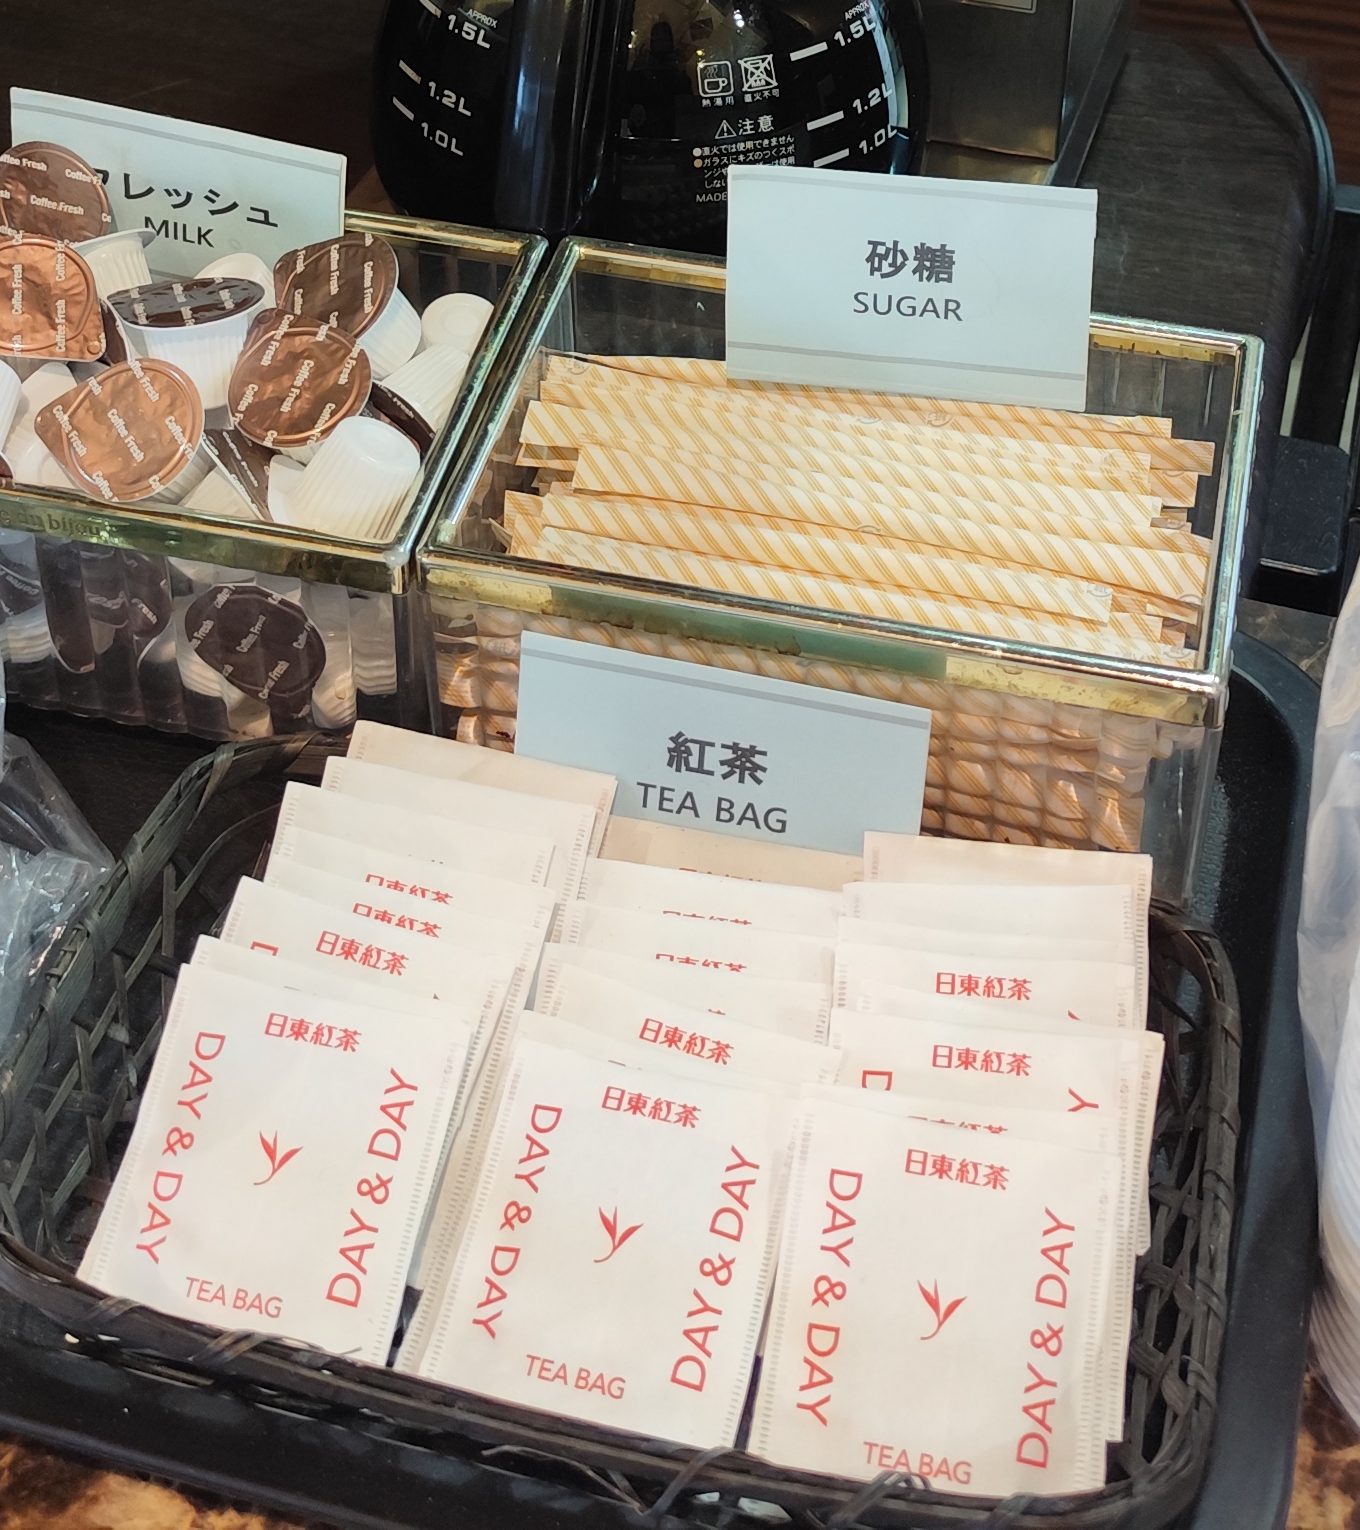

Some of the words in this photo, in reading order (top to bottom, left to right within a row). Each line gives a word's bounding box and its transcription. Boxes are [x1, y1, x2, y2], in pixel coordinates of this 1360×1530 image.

[466, 8, 498, 29] APPROX
[843, 0, 870, 23] APPROX
[446, 13, 491, 50] 1.5L
[833, 17, 877, 48] 1.5L
[428, 81, 472, 117] 1.2L
[744, 89, 780, 103] 直火不可
[851, 83, 893, 115] 1.2L
[421, 122, 464, 157] 1.0L
[738, 115, 774, 136] 注意
[858, 124, 897, 156] 1.0L
[702, 134, 794, 156] 直火では使用できません
[703, 145, 795, 167] ガラスにキズのつくスポ
[22, 158, 47, 172] Fresh
[65, 168, 91, 184] Coffee
[30, 194, 58, 210] Coffee
[58, 202, 85, 216] Fresh
[696, 192, 727, 202] MADE
[145, 216, 214, 248] MILK
[55, 253, 65, 282] Coffee
[330, 243, 340, 271] Coffee
[865, 238, 956, 284] 砂糖
[12, 264, 23, 288] Fresh
[330, 271, 340, 296] Fresh
[363, 261, 374, 288] Coffee
[12, 289, 23, 315] Coffee
[55, 299, 66, 325] Fresh
[363, 288, 374, 314] Fresh
[852, 291, 963, 322] SUGAR
[55, 325, 66, 352] Coffee
[276, 314, 294, 341] Coffee
[260, 338, 280, 366] Fresh
[294, 359, 315, 388] Coffee
[338, 356, 357, 385] Fresh
[140, 376, 159, 403] Fresh
[237, 383, 259, 413] Coffee
[280, 385, 300, 413] Fresh
[52, 404, 71, 434] Coffee
[68, 430, 87, 457] Fresh
[107, 408, 128, 438] Coffee
[124, 434, 145, 463] Fresh
[165, 415, 187, 446] Coffee
[666, 731, 767, 786] 紅茶
[636, 781, 702, 821] TEA
[714, 796, 788, 835] BAG
[315, 930, 409, 977] 日東紅茶
[935, 972, 1032, 1001] 日東紅茶
[265, 1012, 362, 1052] 日東紅茶
[639, 1017, 734, 1066] 日東紅茶
[177, 1031, 226, 1120] DAY
[932, 1044, 1032, 1077] 日東紅茶
[367, 1067, 419, 1161] DAY
[601, 1085, 702, 1129] 日東紅茶
[162, 1127, 195, 1156] &
[514, 1103, 563, 1193] DAY
[905, 1148, 1010, 1191] 日東紅茶
[356, 1172, 394, 1205] &
[709, 1145, 760, 1242] DAY
[136, 1171, 183, 1264] DAY
[500, 1200, 532, 1231] &
[820, 1168, 863, 1268] DAY
[326, 1208, 379, 1308] DAY
[699, 1253, 737, 1287] &
[1035, 1206, 1076, 1310] DAY
[185, 1276, 227, 1306] TEA
[233, 1287, 283, 1319] BAG
[472, 1245, 521, 1340] DAY
[811, 1274, 847, 1308] &
[670, 1288, 723, 1392] DAY
[1029, 1322, 1065, 1357] &
[526, 1354, 568, 1386] TEA
[575, 1367, 626, 1400] BAG
[796, 1322, 841, 1427] DAY
[1016, 1362, 1058, 1469] DAY
[863, 1441, 910, 1471] TEA
[918, 1453, 973, 1485] BAG
